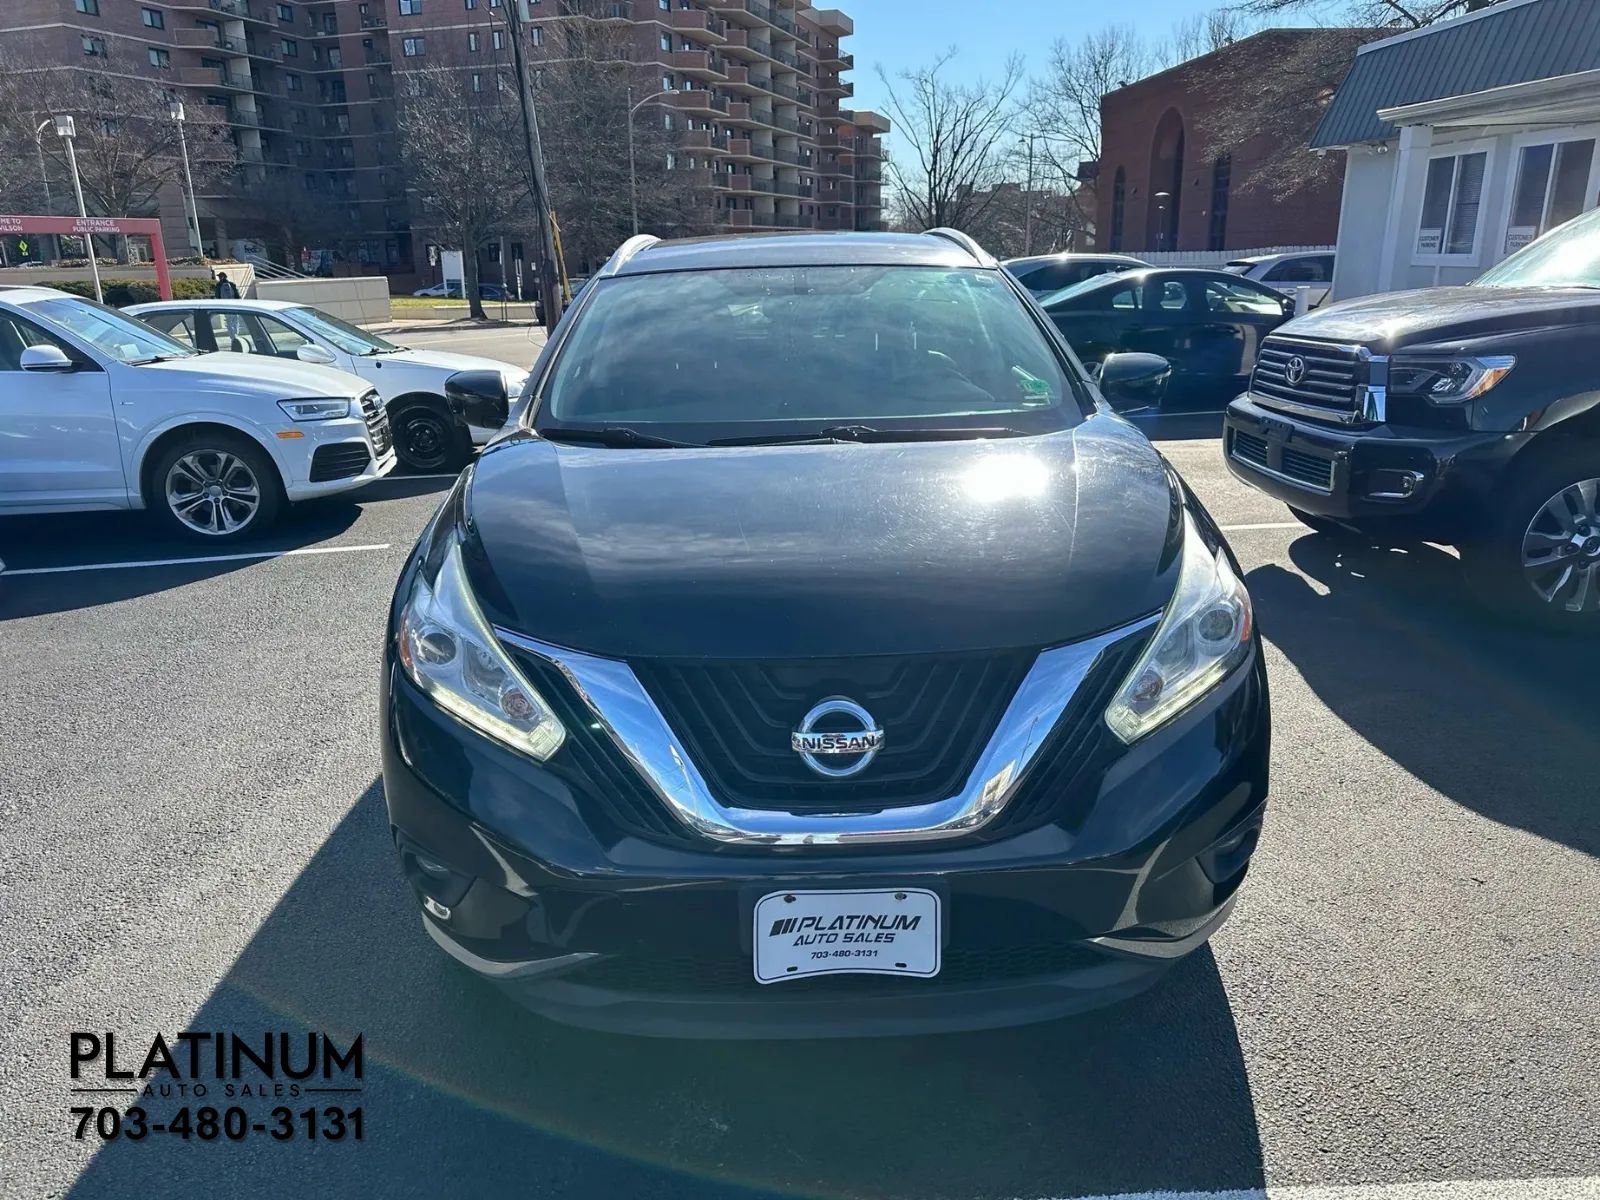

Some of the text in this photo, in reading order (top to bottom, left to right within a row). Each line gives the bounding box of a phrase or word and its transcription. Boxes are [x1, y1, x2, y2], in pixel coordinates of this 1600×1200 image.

[75, 219, 115, 227] ENTRANCE
[802, 735, 875, 750] NISSAN
[797, 915, 922, 933] PLATINUM
[792, 932, 896, 947] AUTO SALES
[811, 949, 878, 960] 703-480-3131
